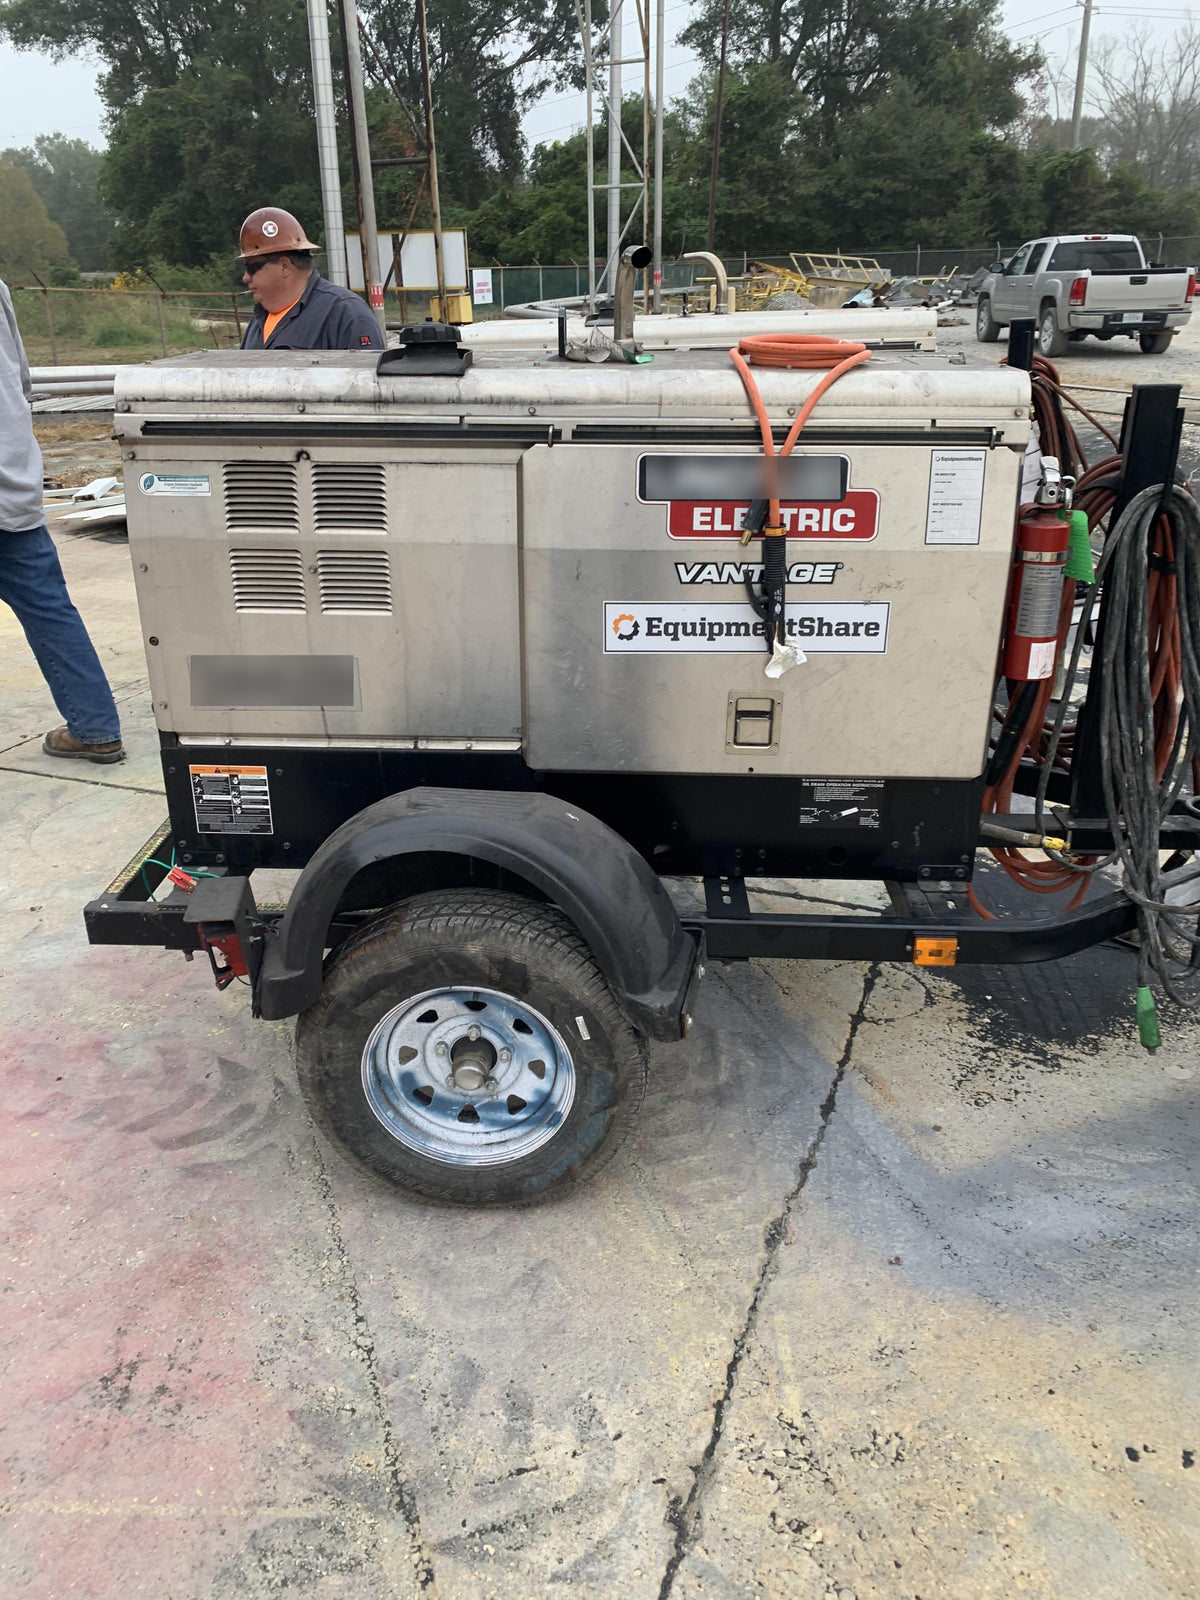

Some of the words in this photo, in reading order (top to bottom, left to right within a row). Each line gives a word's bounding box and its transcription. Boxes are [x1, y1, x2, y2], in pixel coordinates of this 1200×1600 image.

[693, 507, 856, 532] ELETRIC
[675, 562, 838, 584] VANTGE
[645, 617, 880, 641] EquipmetShare
